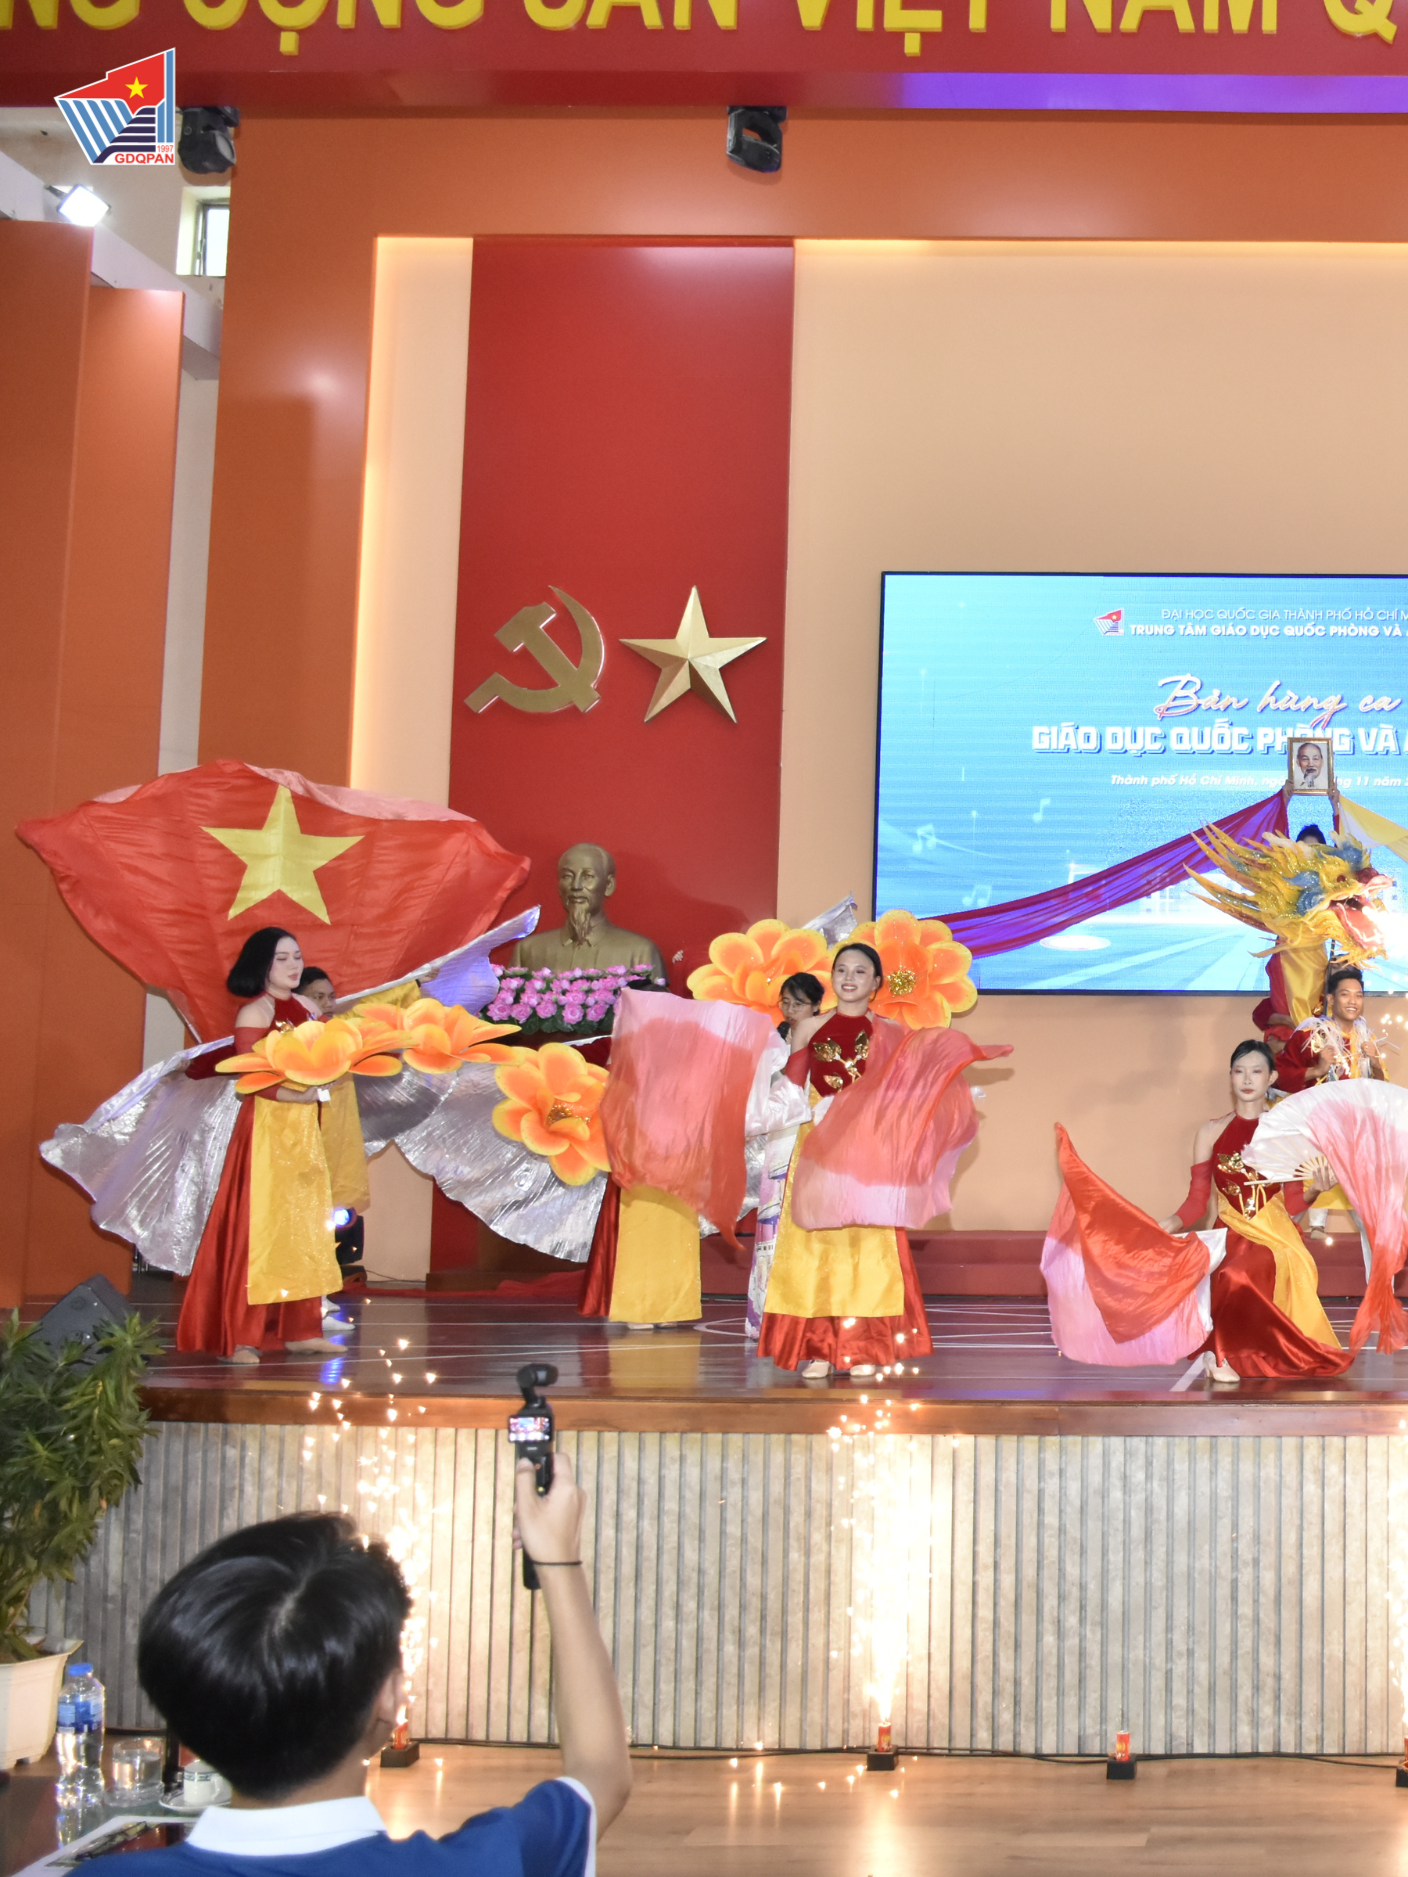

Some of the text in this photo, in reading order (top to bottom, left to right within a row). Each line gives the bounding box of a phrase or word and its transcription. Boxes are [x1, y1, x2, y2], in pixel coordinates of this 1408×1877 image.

[1162, 608, 1182, 622] ĐẠI
[1186, 609, 1214, 622] HỌC
[1218, 606, 1254, 620] QUỐC
[1259, 609, 1281, 620] GIA
[1284, 608, 1323, 620] THÀNH
[1326, 607, 1352, 620] PHỐ
[1377, 608, 1398, 620] CHÍ
[1130, 624, 1175, 636] TRUNG
[1178, 622, 1208, 636] TÂM
[1210, 623, 1247, 636] GIÁO
[1250, 625, 1280, 638] DỤC
[1284, 622, 1326, 636] QUỐC
[1330, 624, 1380, 636] PHÒNG
[1383, 624, 1402, 636] VÀ
[1256, 680, 1347, 729] hùng
[1358, 694, 1401, 713] ca
[1032, 722, 1100, 753] GIÁO
[1105, 727, 1165, 756] DỤC
[1170, 718, 1252, 754] QUỐC
[1358, 724, 1400, 754] VÀ
[1111, 774, 1148, 785] Thành
[1151, 774, 1178, 787] phố
[1200, 775, 1223, 786] Chí
[1224, 776, 1258, 786] Minh,
[1262, 776, 1286, 788] ngà
[1356, 776, 1370, 786] 11
[1374, 776, 1401, 786] năm
